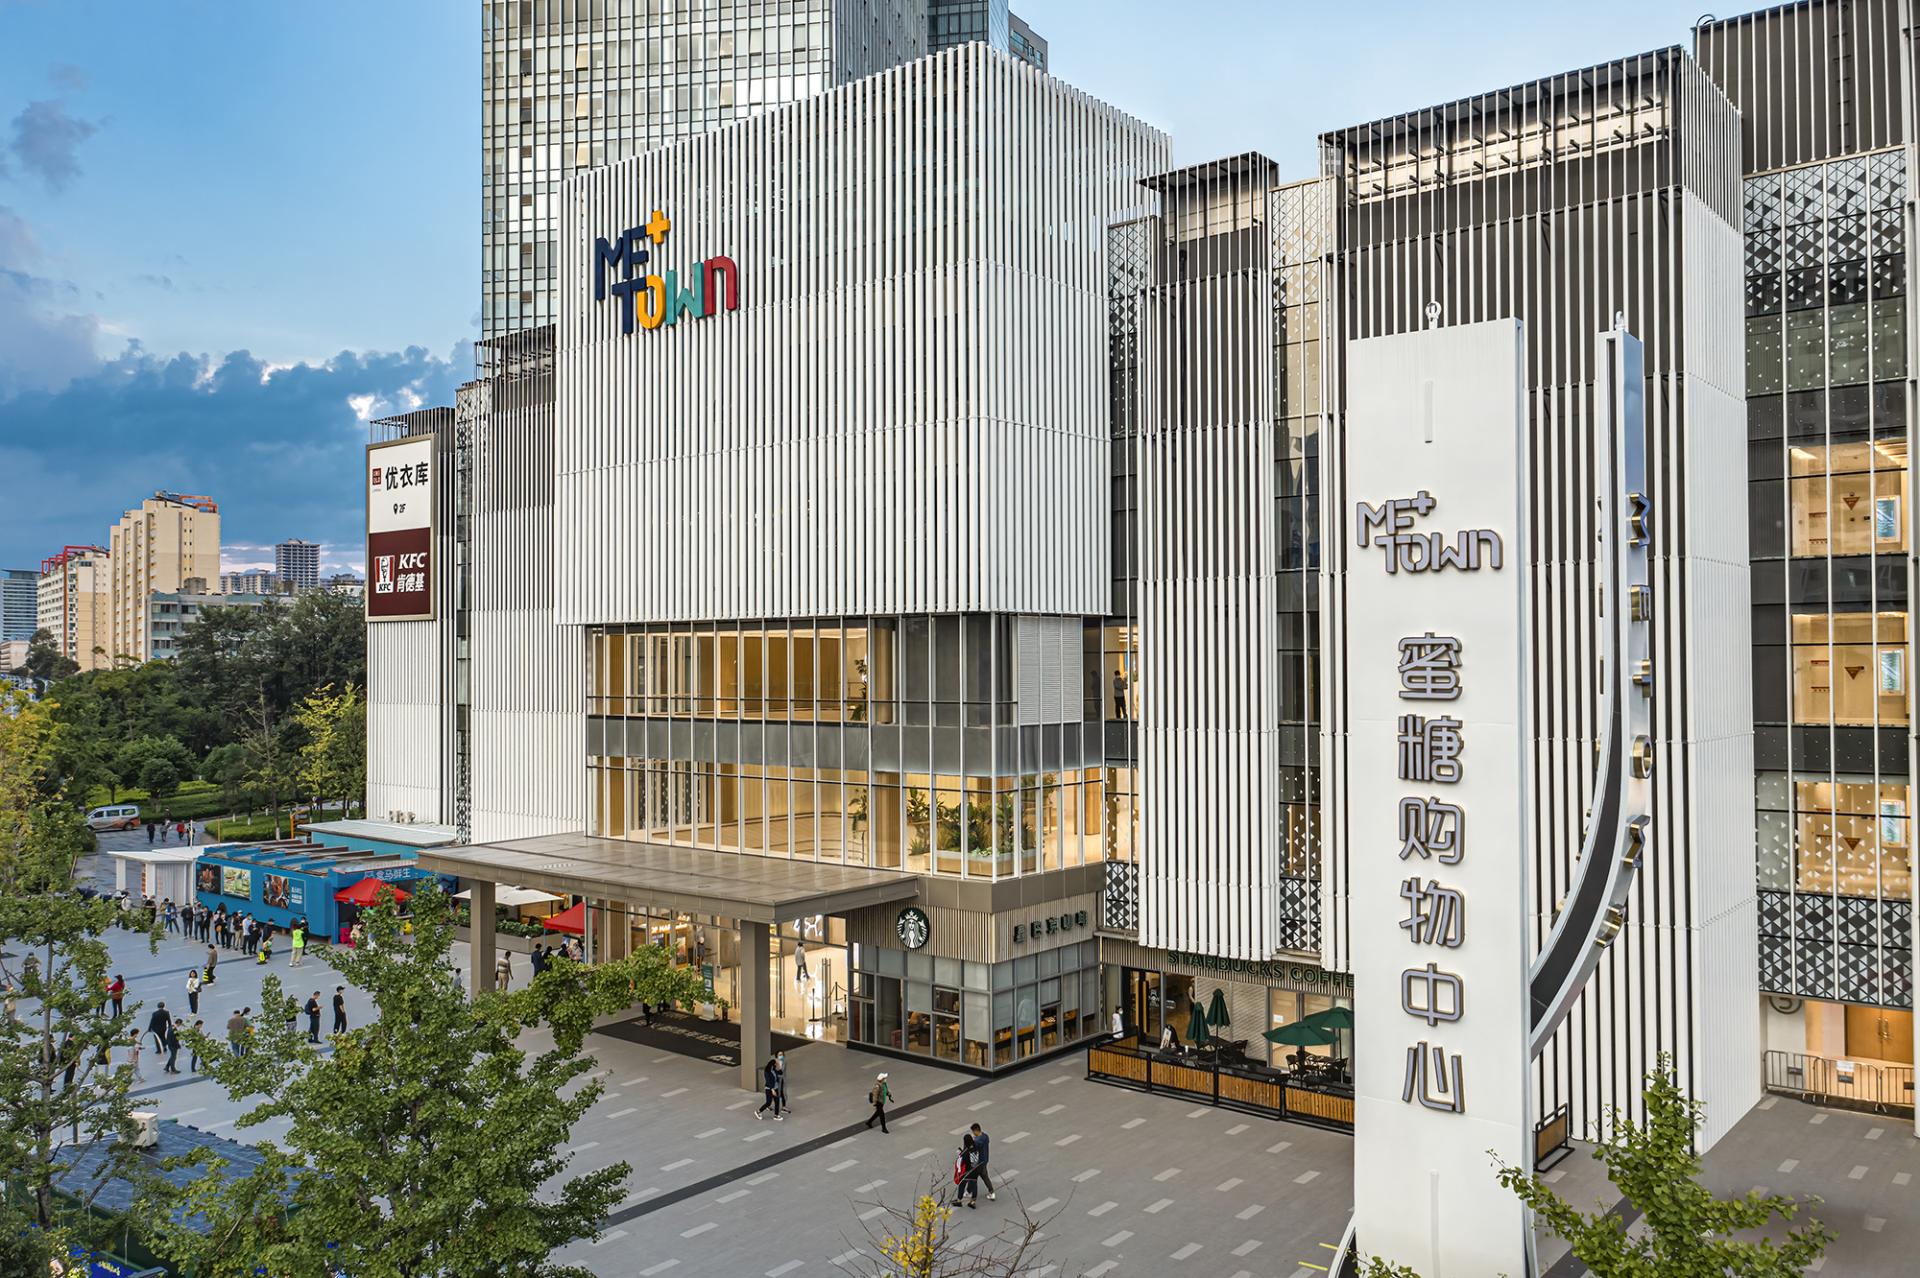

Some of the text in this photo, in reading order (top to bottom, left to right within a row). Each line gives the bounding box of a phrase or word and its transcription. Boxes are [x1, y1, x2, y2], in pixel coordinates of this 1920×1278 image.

[385, 461, 429, 491] 优衣库
[398, 551, 428, 570] KFC
[378, 583, 391, 592] KFC
[396, 571, 426, 592] 肯德基
[1398, 632, 1466, 1114] 蜜糖购物中心
[1168, 951, 1284, 979] STARBUCKS
